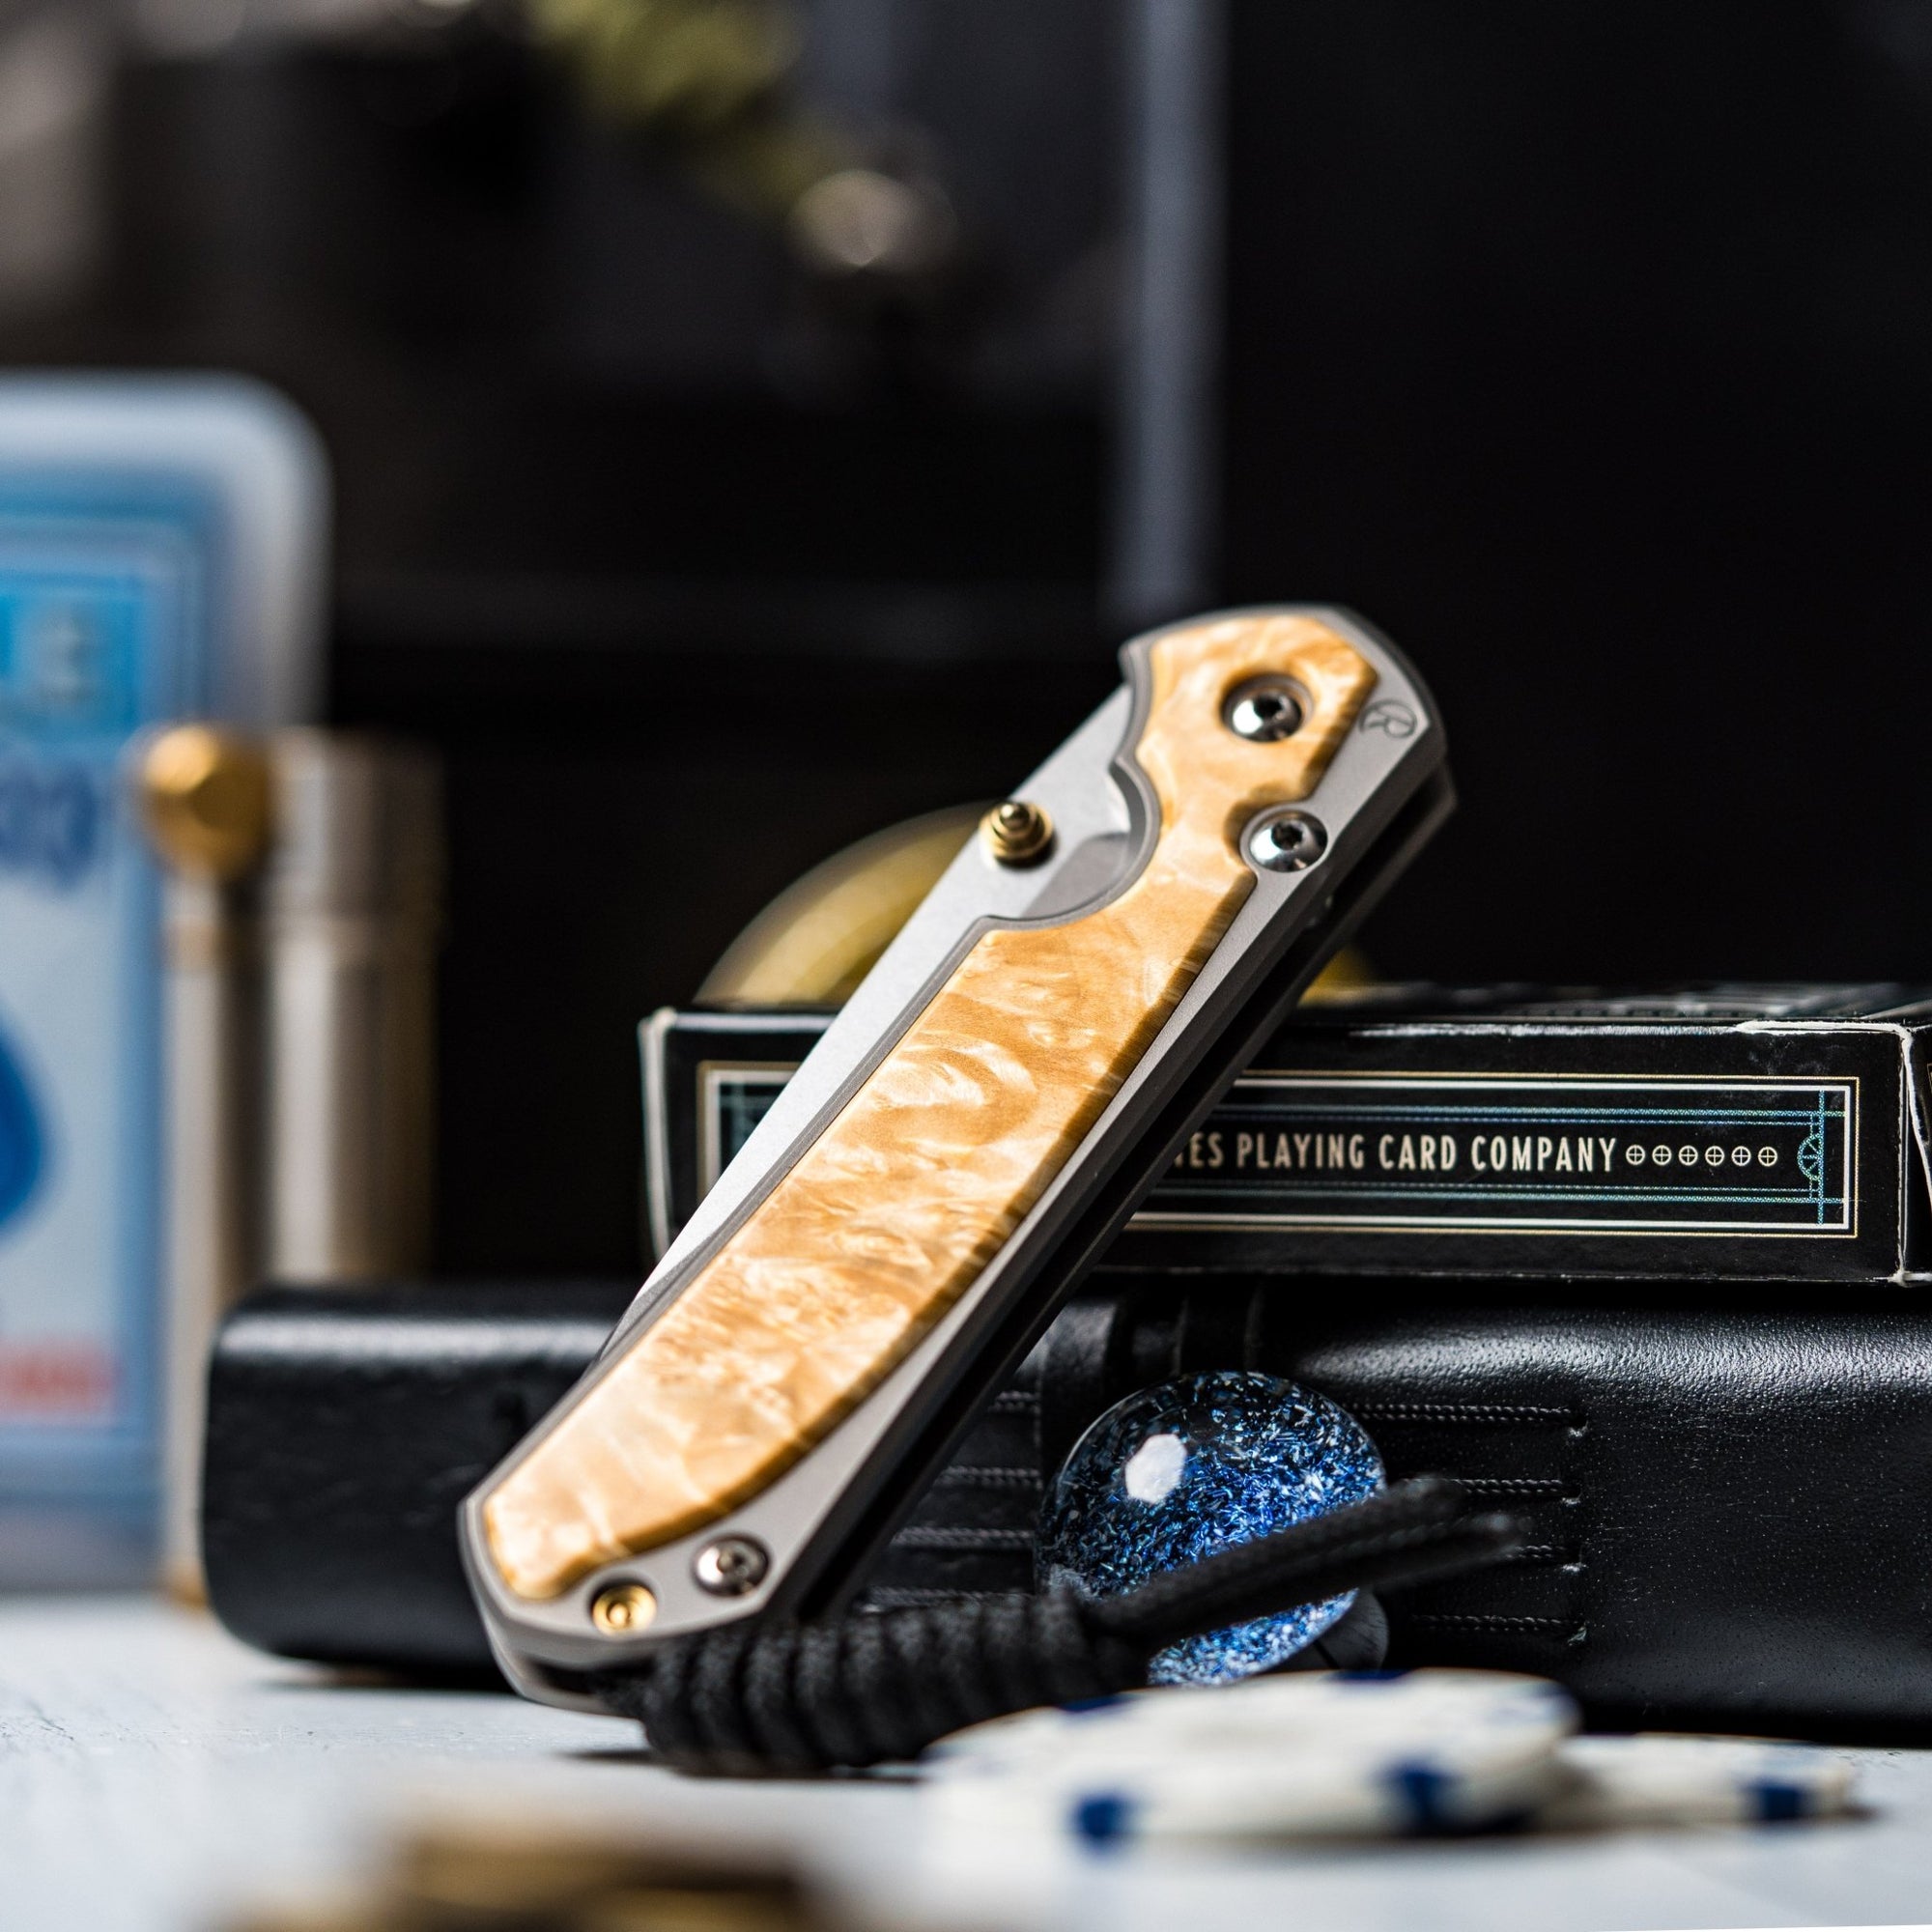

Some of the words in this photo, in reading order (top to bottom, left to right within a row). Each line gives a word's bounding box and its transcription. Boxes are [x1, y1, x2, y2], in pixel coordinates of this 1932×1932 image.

[1174, 1132, 1224, 1168] ES
[1236, 1132, 1364, 1170] PLAYING
[1378, 1134, 1457, 1170] CARD
[1470, 1135, 1616, 1172] COMPANY
